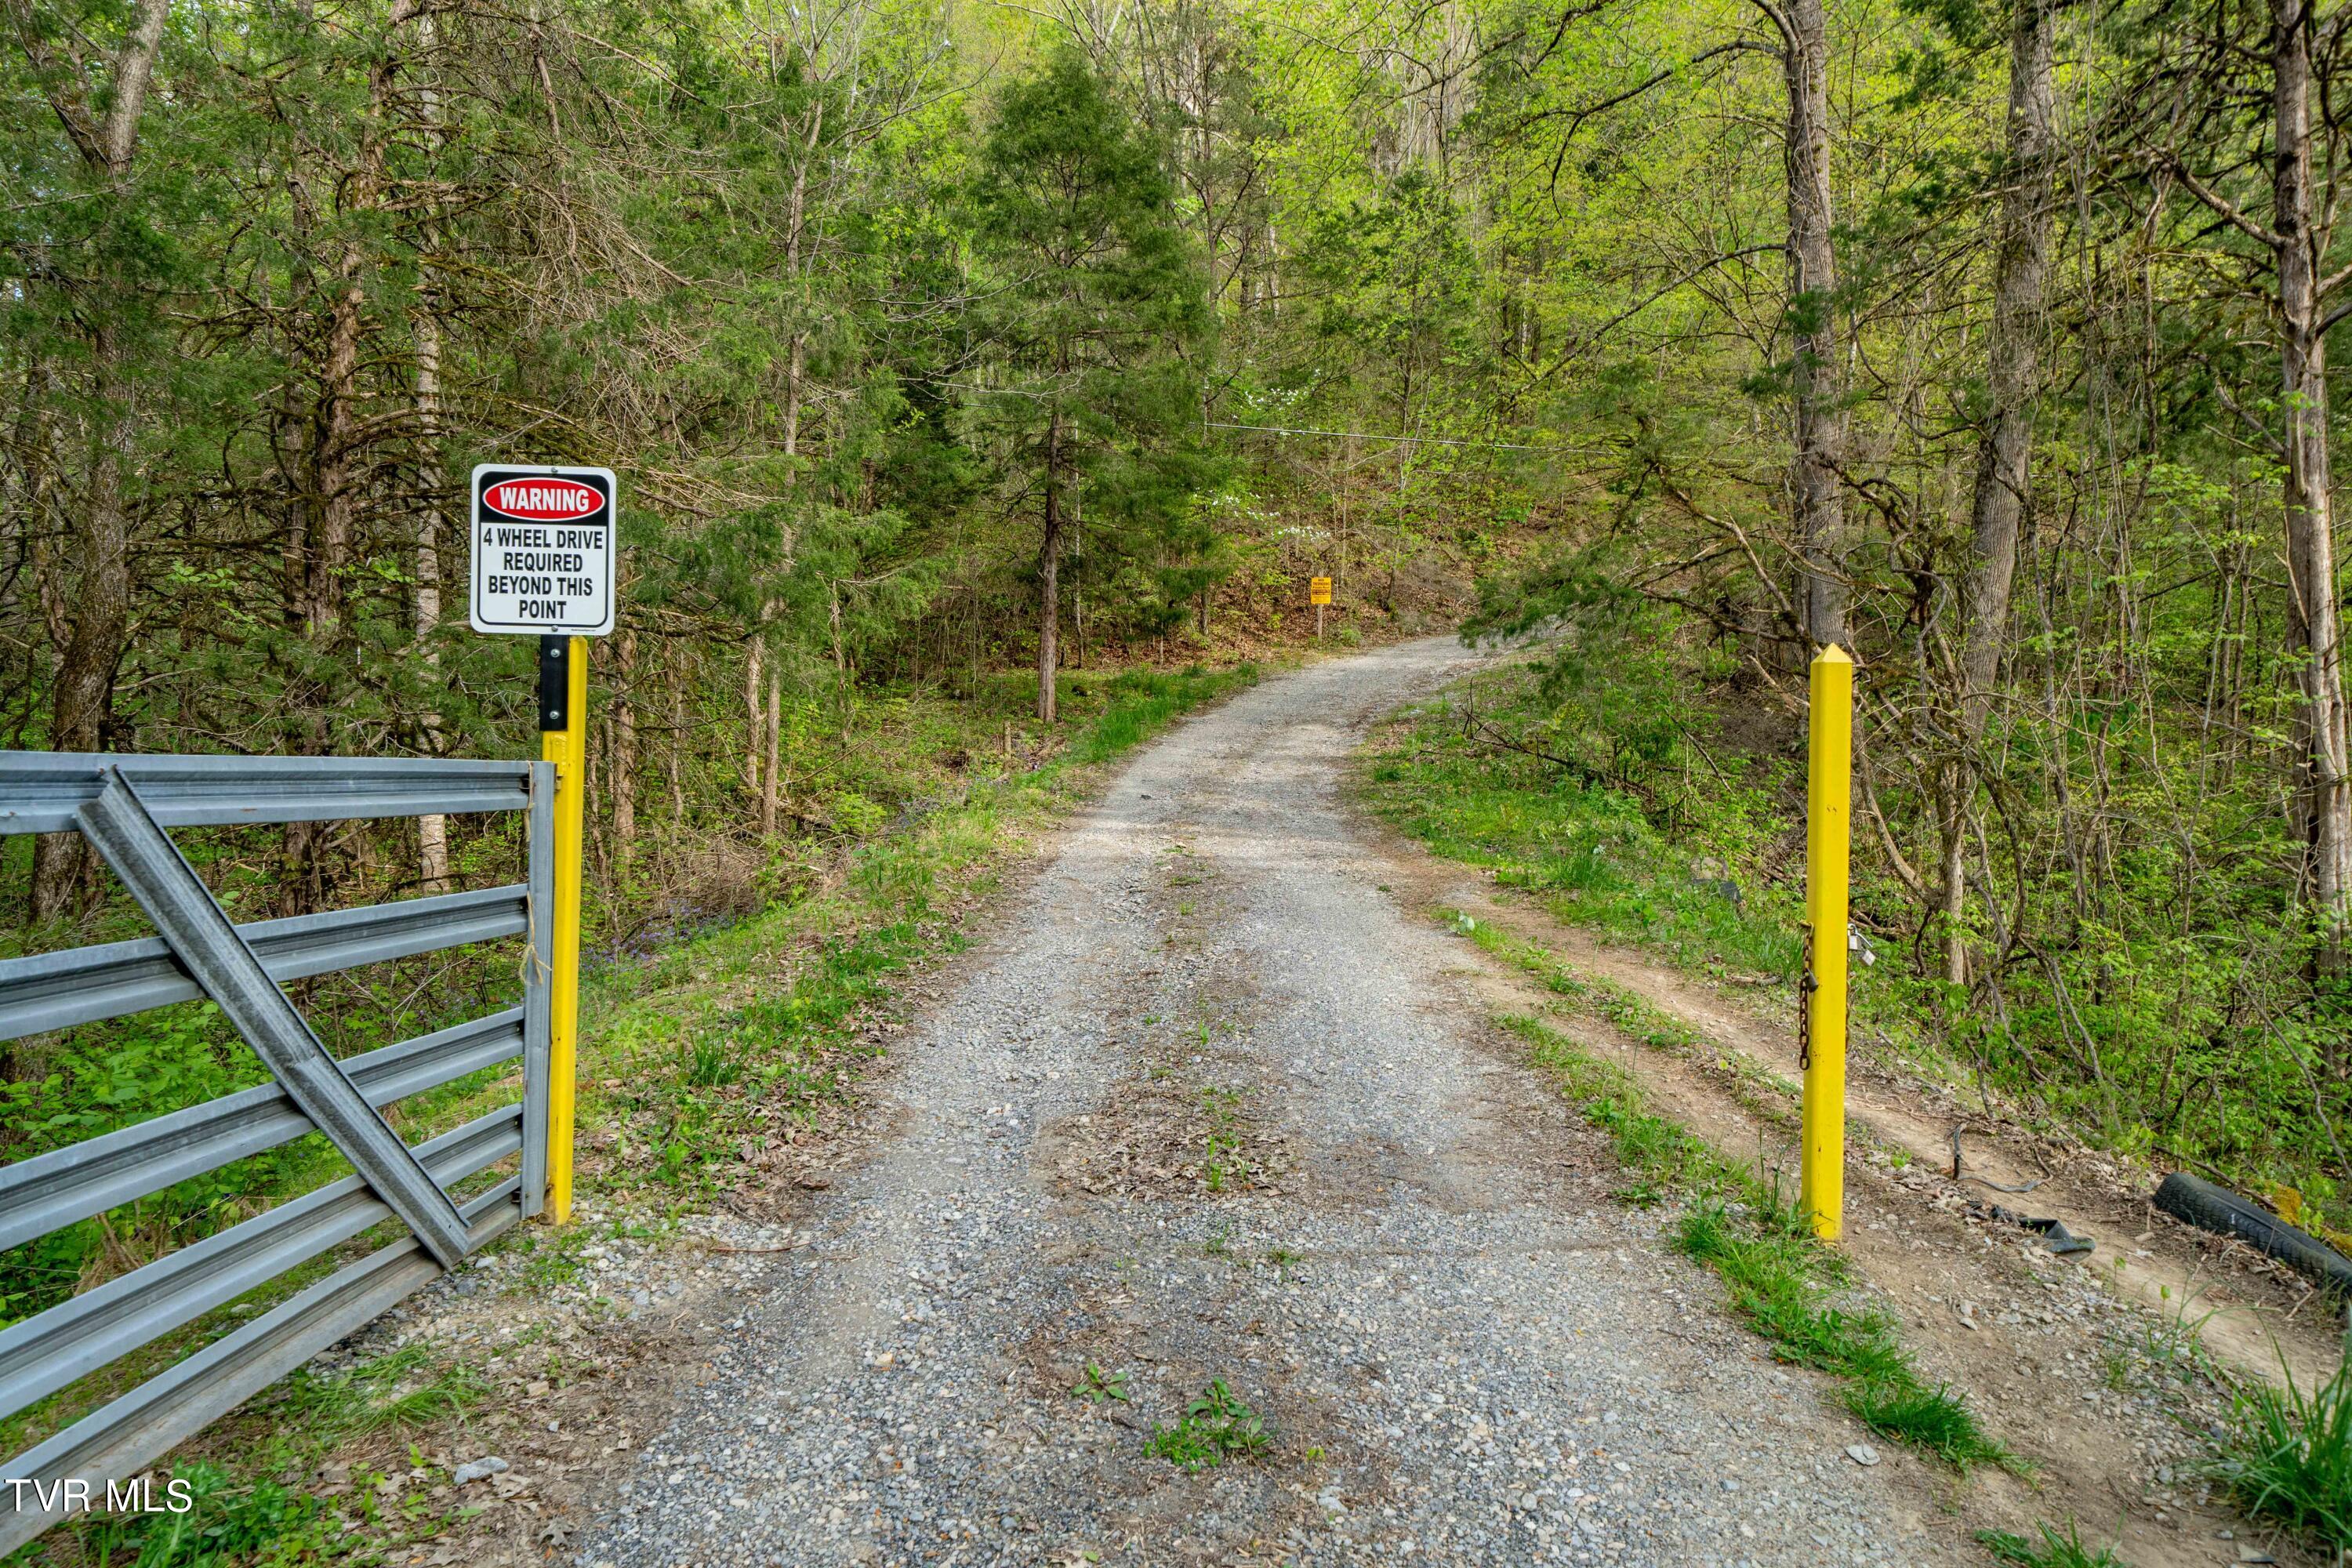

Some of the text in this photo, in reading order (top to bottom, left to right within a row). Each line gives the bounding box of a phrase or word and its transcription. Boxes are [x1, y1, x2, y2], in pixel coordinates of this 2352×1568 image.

[499, 487, 589, 512] WARNING
[483, 528, 603, 549] 4 WHEEL DRIVE
[503, 552, 583, 572] REQUIRED
[488, 575, 593, 597] BEYOND THIS
[519, 600, 567, 619] POINT
